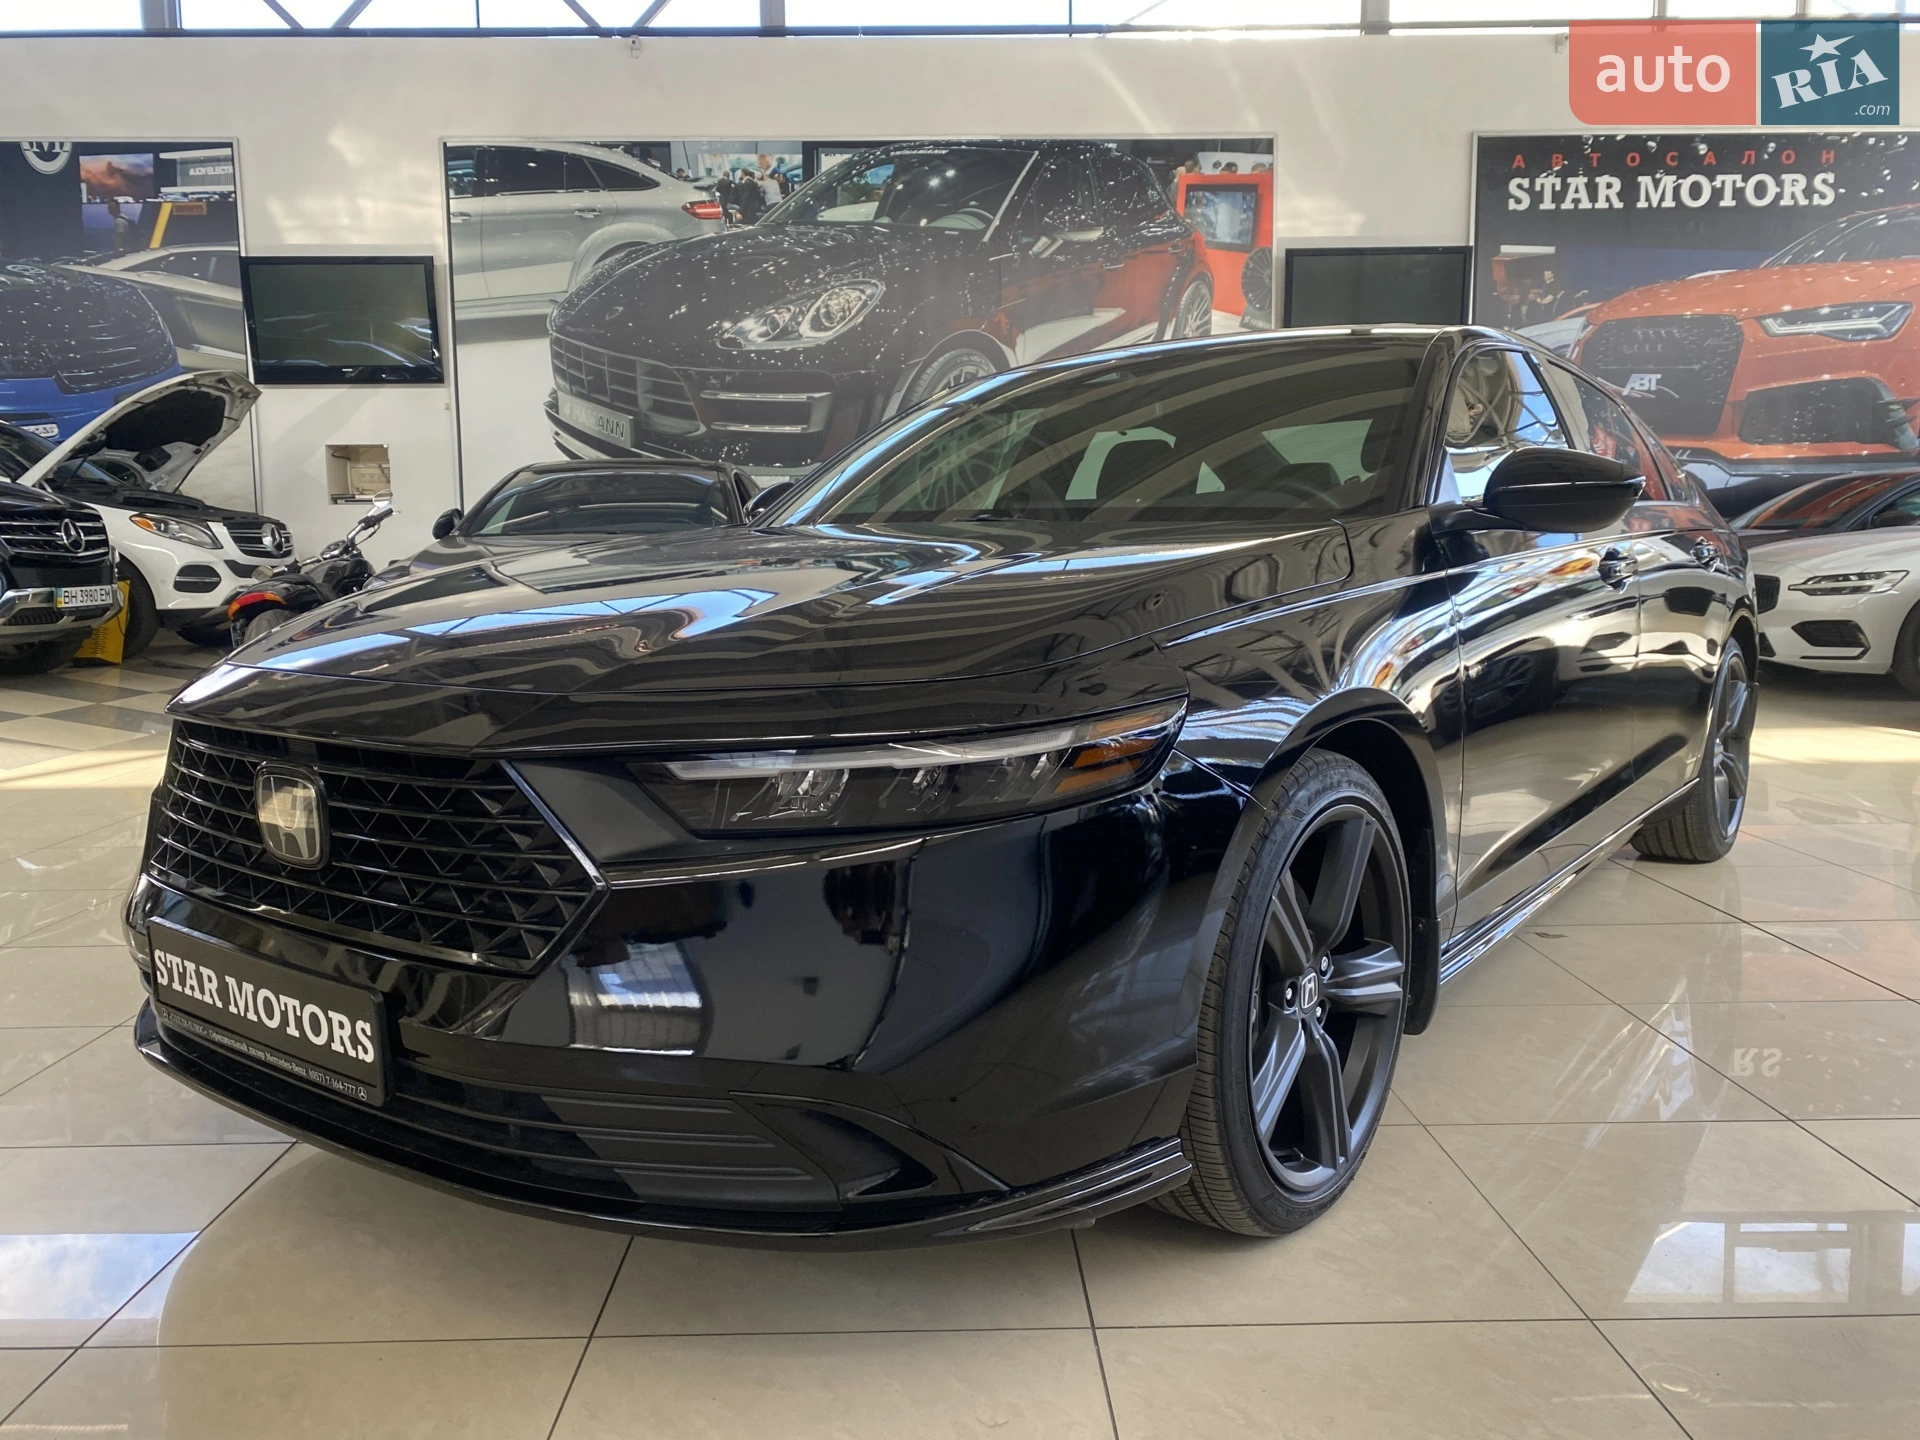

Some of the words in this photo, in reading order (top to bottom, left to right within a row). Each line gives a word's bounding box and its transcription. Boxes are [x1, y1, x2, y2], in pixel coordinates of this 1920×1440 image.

[1508, 174, 1624, 211] STAR
[1637, 172, 1836, 209] MOTORS
[1622, 374, 1662, 396] ABT
[572, 403, 625, 440] HAMANN
[63, 590, 77, 605] BH
[80, 589, 98, 603] 3980
[100, 588, 111, 602] EM
[154, 948, 222, 1009] STAR
[225, 975, 375, 1064] MOTORS
